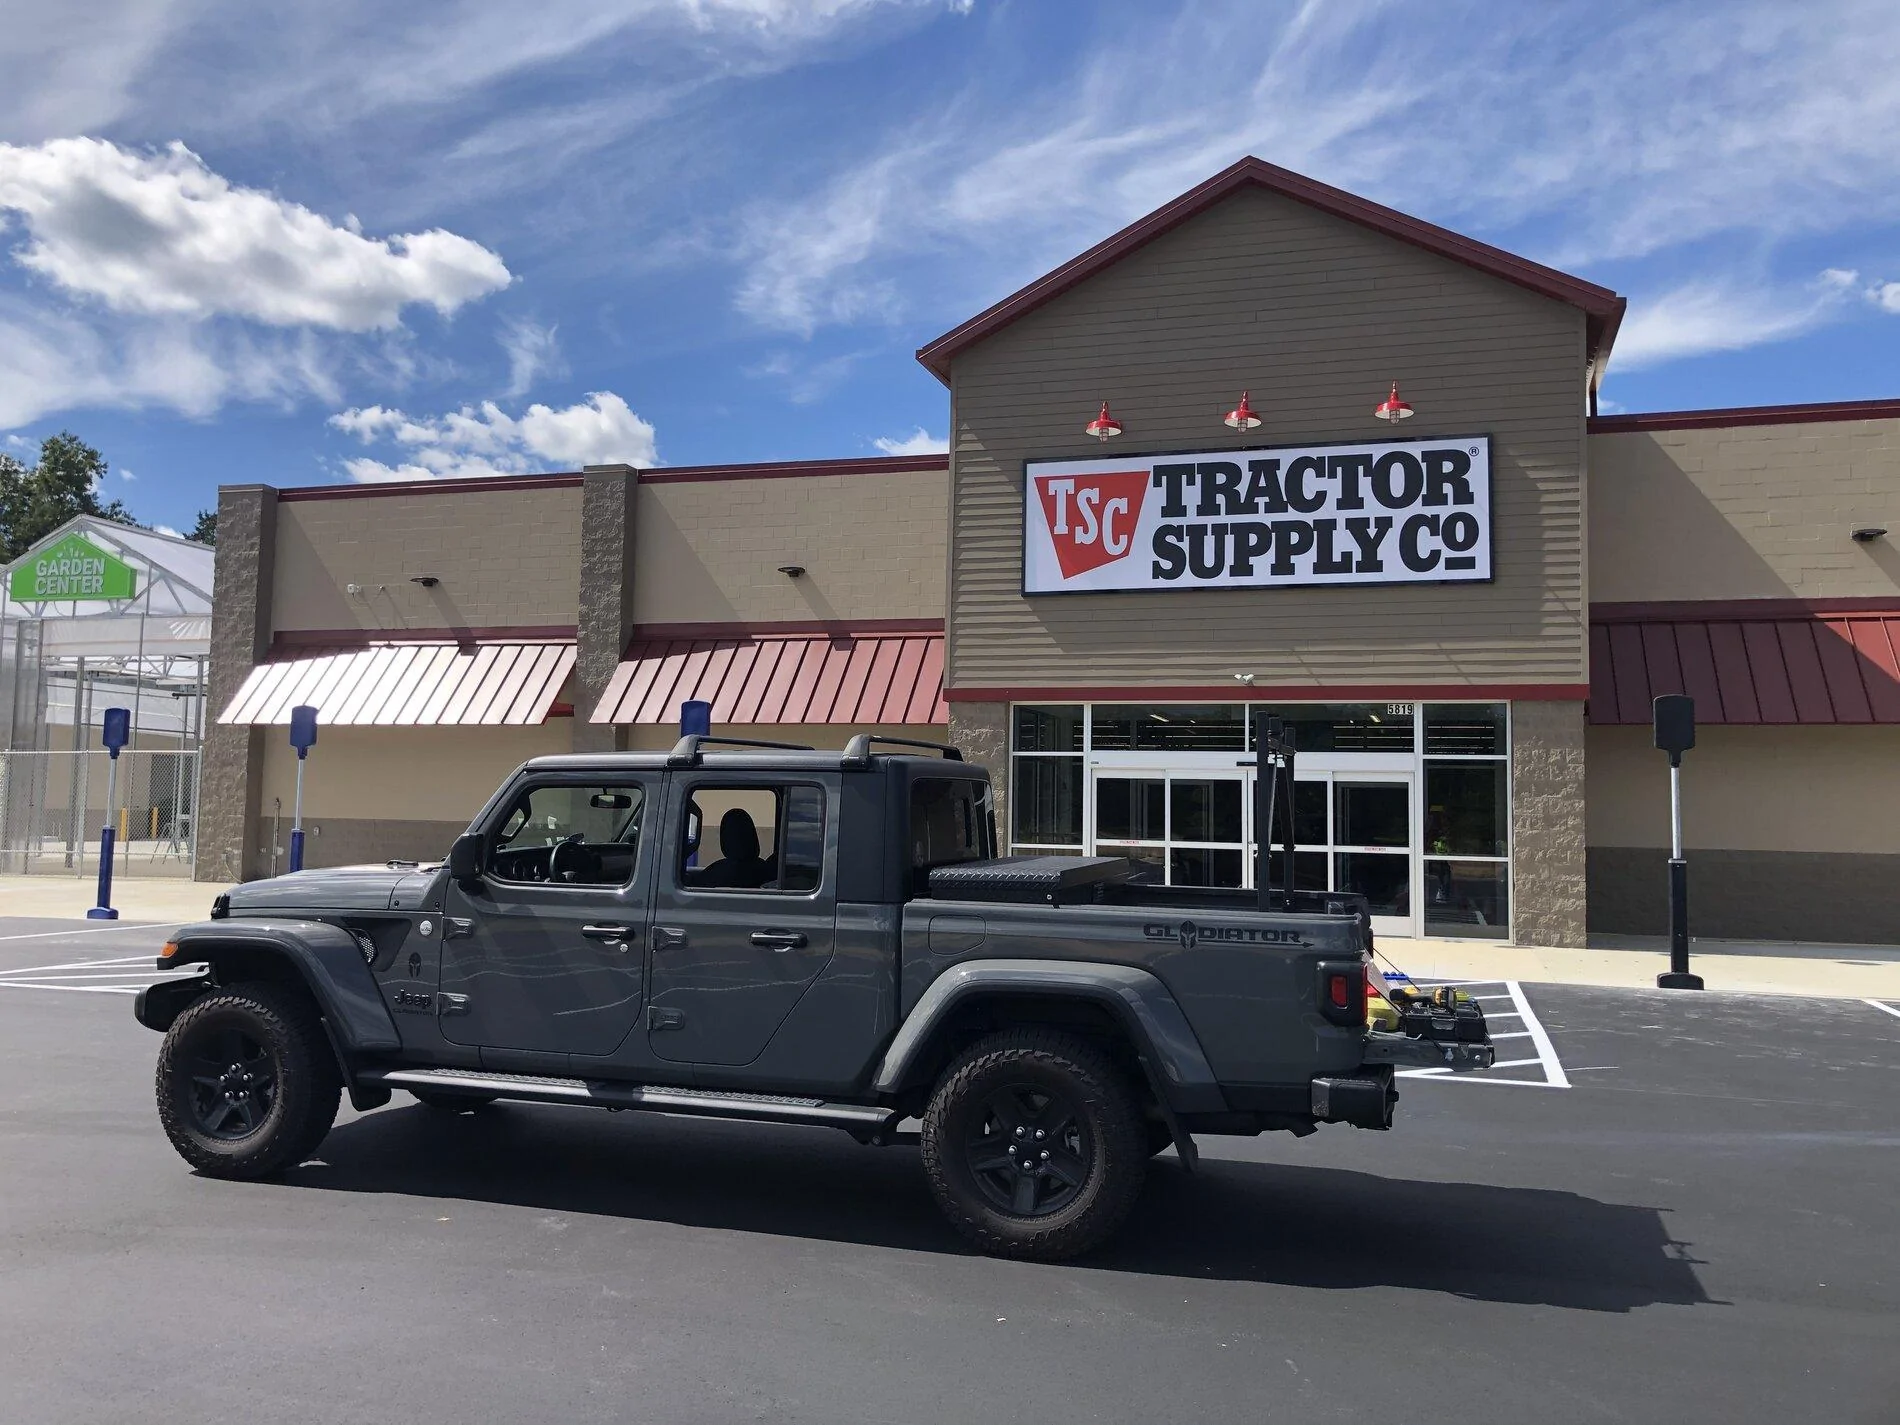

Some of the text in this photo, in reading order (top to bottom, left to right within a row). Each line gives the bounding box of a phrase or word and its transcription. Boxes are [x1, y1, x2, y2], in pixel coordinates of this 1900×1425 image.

[1048, 478, 1128, 556] TSC
[1152, 515, 1393, 580] SUPPLY
[36, 558, 106, 577] GARDEN
[35, 575, 104, 595] CENTER
[1388, 704, 1413, 715] 5819
[1143, 921, 1301, 946] GLDIATOR
